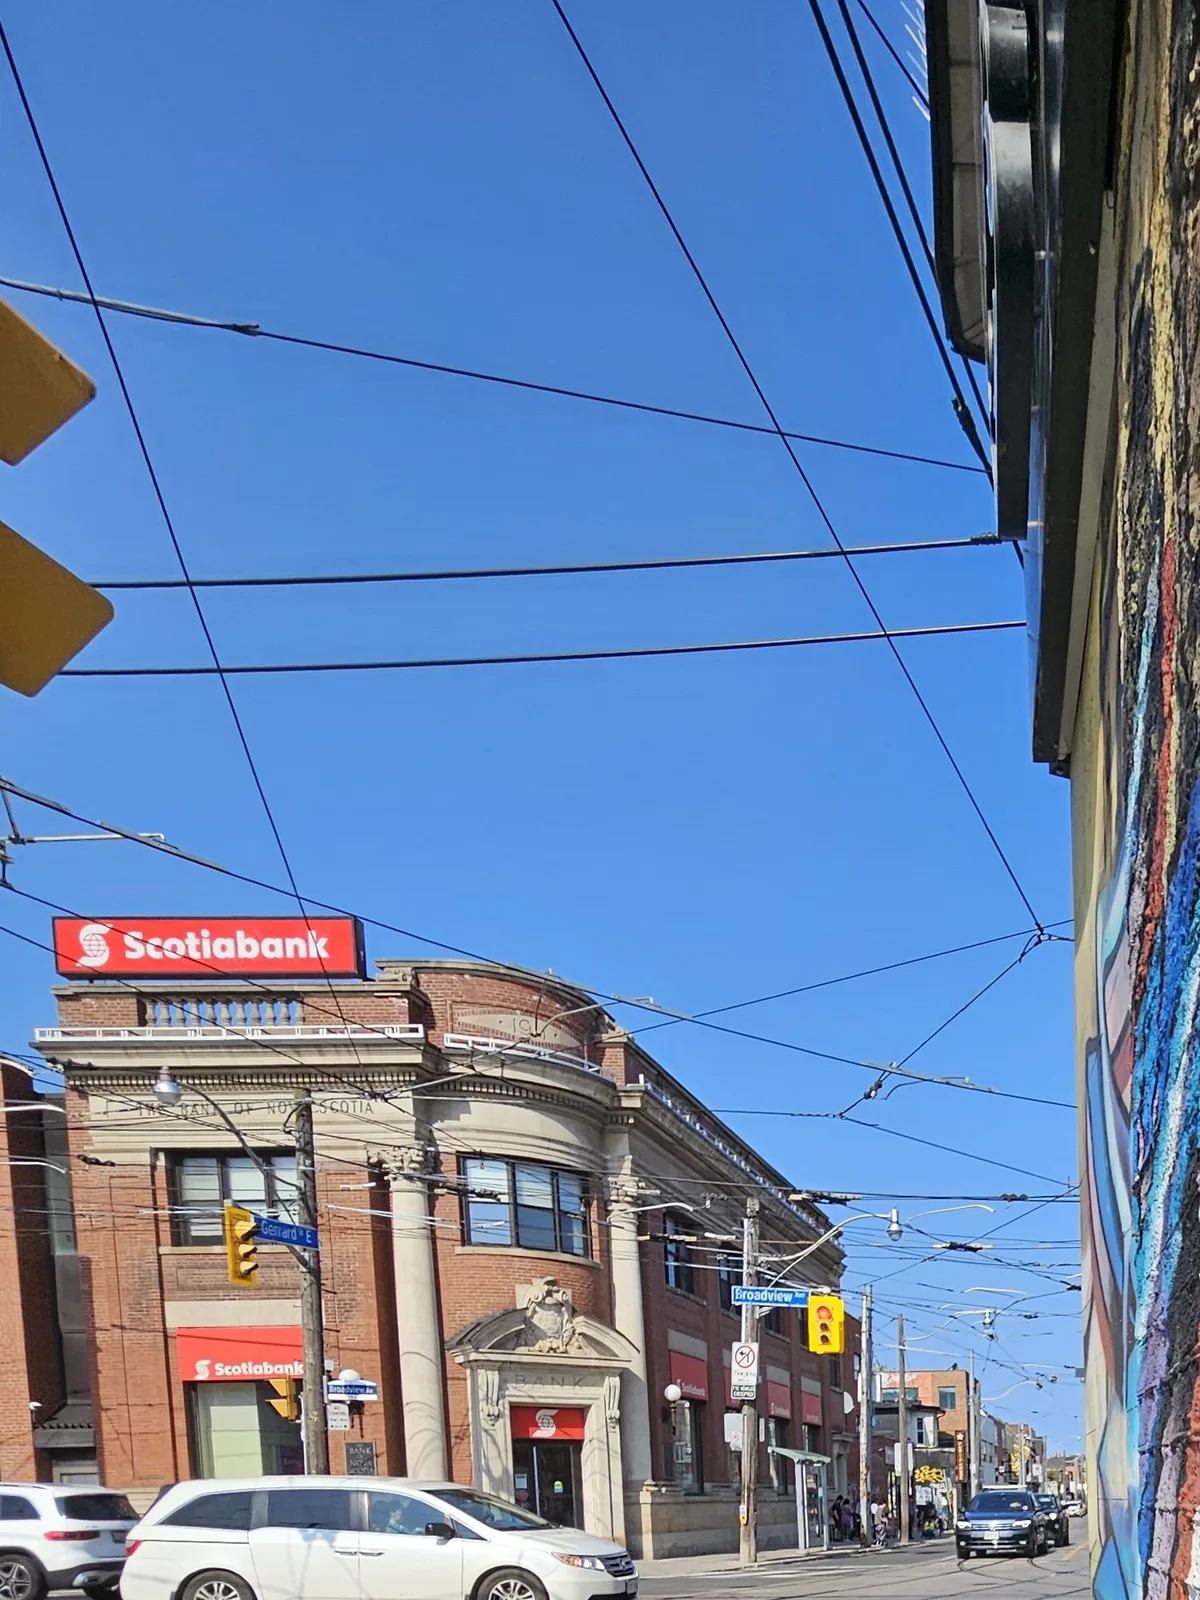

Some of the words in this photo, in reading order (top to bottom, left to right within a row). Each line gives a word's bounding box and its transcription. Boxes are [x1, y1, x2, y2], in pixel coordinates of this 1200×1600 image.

[123, 929, 330, 959] Scotiabank
[319, 1100, 374, 1114] SCOTIA
[261, 1220, 298, 1241] Gerrard
[305, 1230, 313, 1244] E
[735, 1287, 793, 1302] Broadview
[214, 1361, 304, 1377] Scotiabank
[328, 1385, 366, 1394] Broadview
[515, 1374, 585, 1390] BANK
